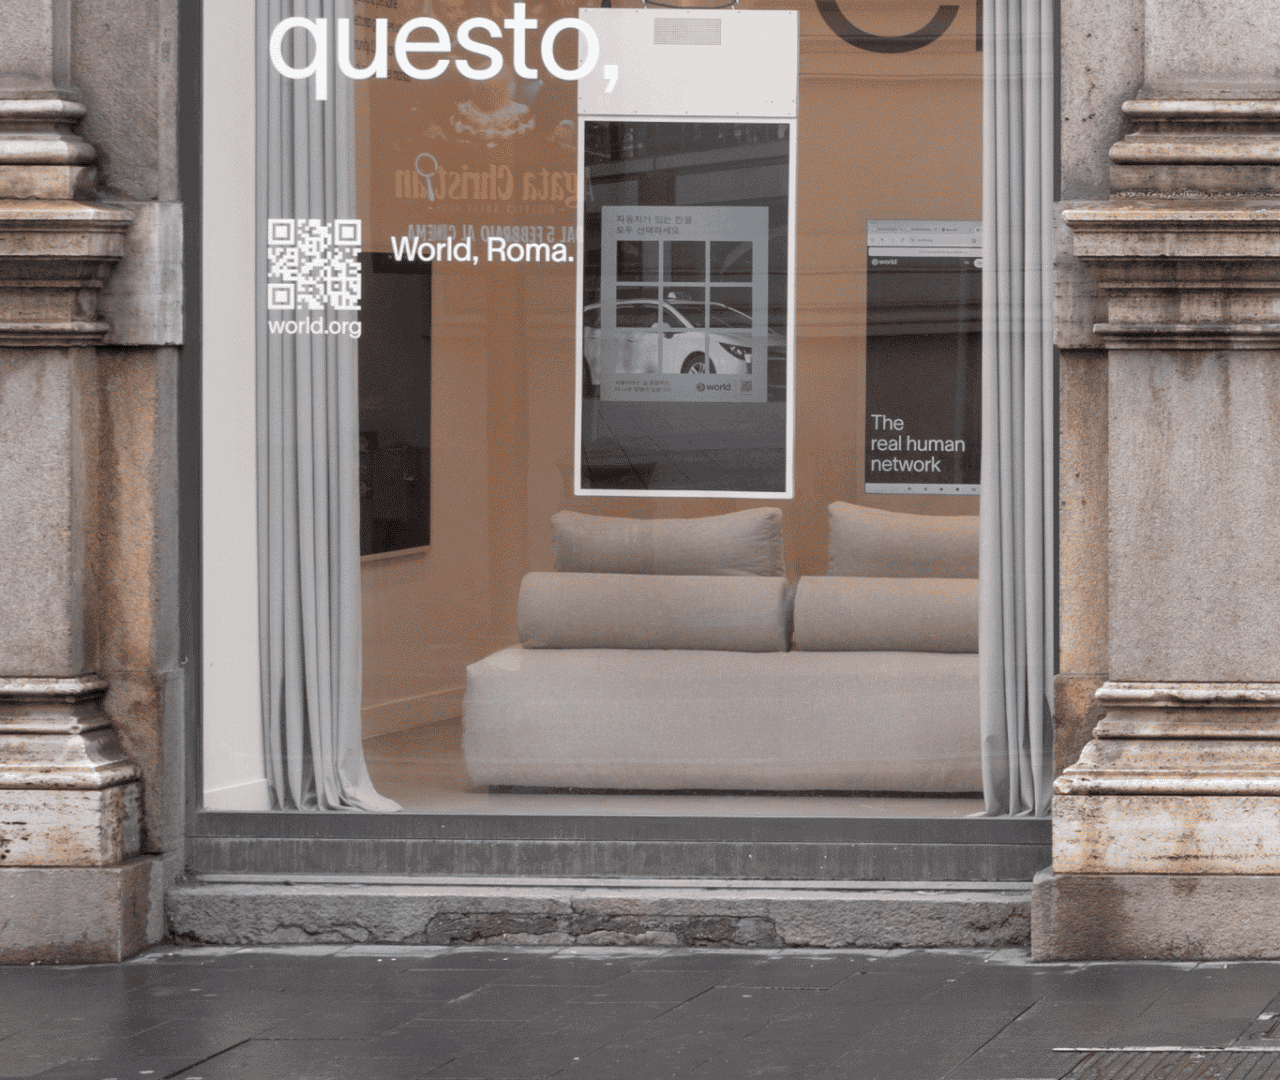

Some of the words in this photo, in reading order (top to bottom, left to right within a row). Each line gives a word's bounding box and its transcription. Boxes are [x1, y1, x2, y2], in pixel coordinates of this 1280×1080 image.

[269, 3, 619, 100] questo,
[391, 236, 479, 266] World,
[488, 237, 574, 263] Roma.
[268, 317, 362, 338] world.org
[706, 383, 732, 392] world
[871, 414, 904, 430] The
[871, 435, 902, 451] real
[906, 435, 966, 452] human
[871, 456, 942, 472] network
